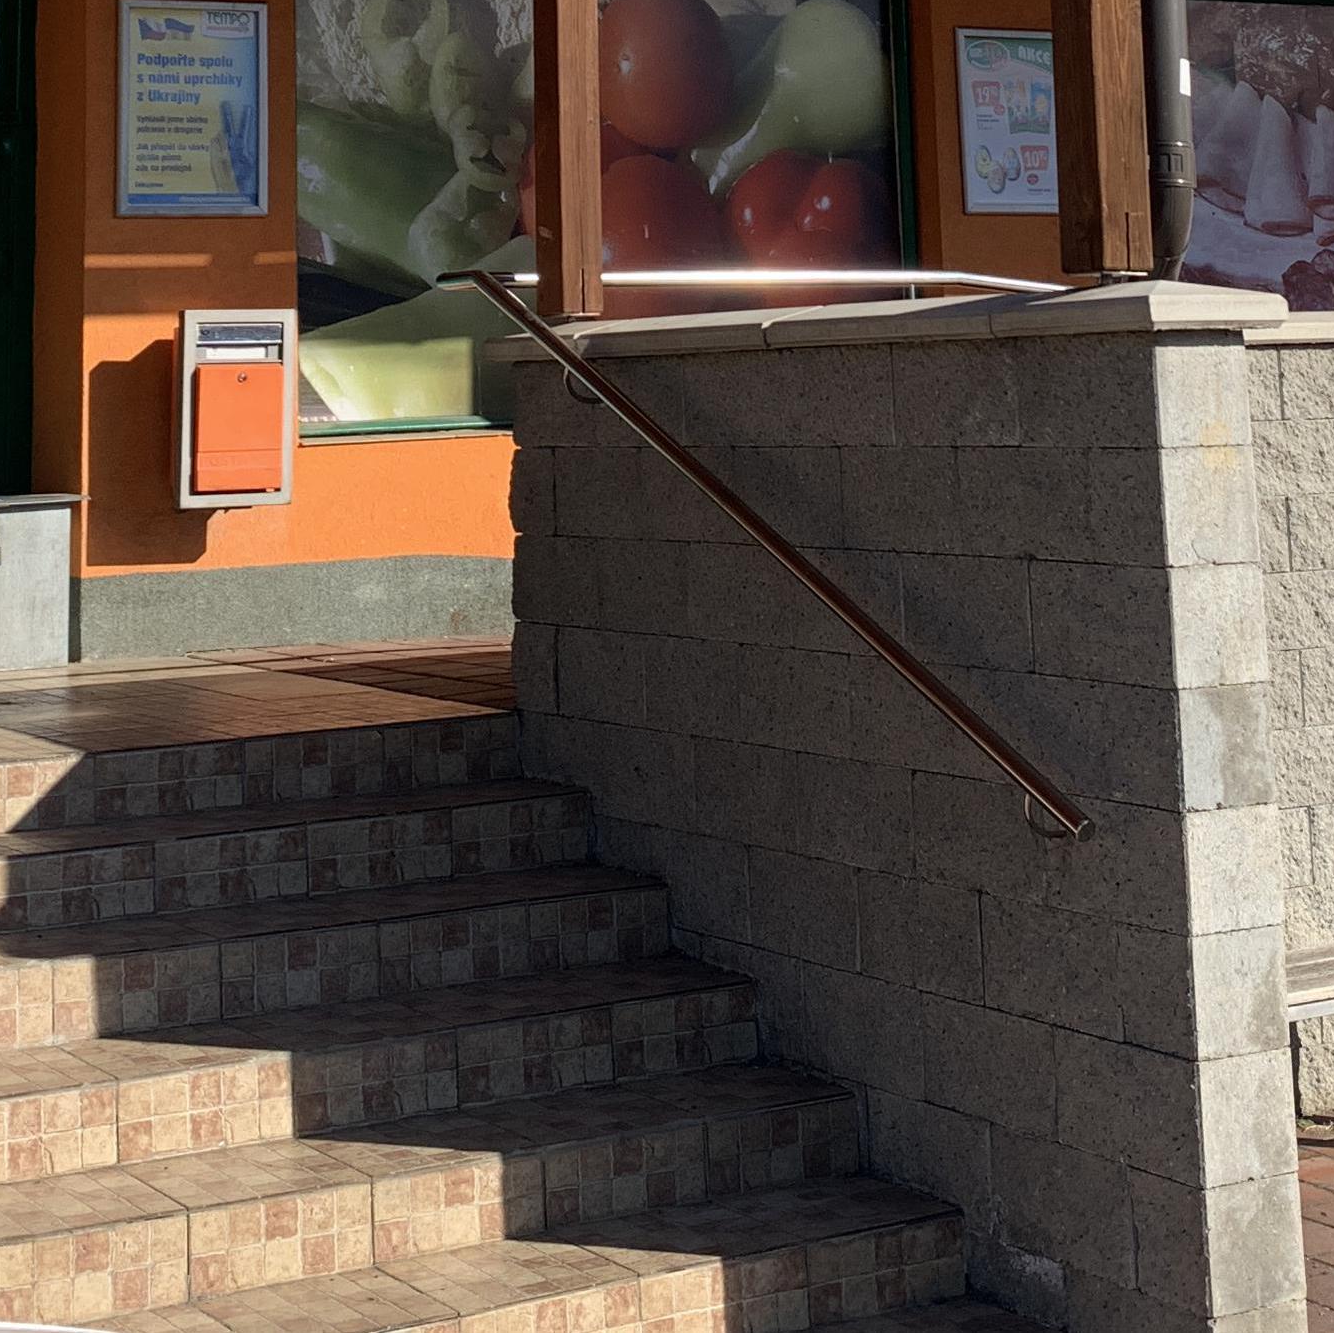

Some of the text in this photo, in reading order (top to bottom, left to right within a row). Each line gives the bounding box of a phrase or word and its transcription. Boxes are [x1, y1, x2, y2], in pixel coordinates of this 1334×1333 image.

[137, 53, 233, 69] Podpořte spolu
[137, 72, 243, 87] s námi uprchlíky
[137, 89, 201, 104] z Ukrajiny
